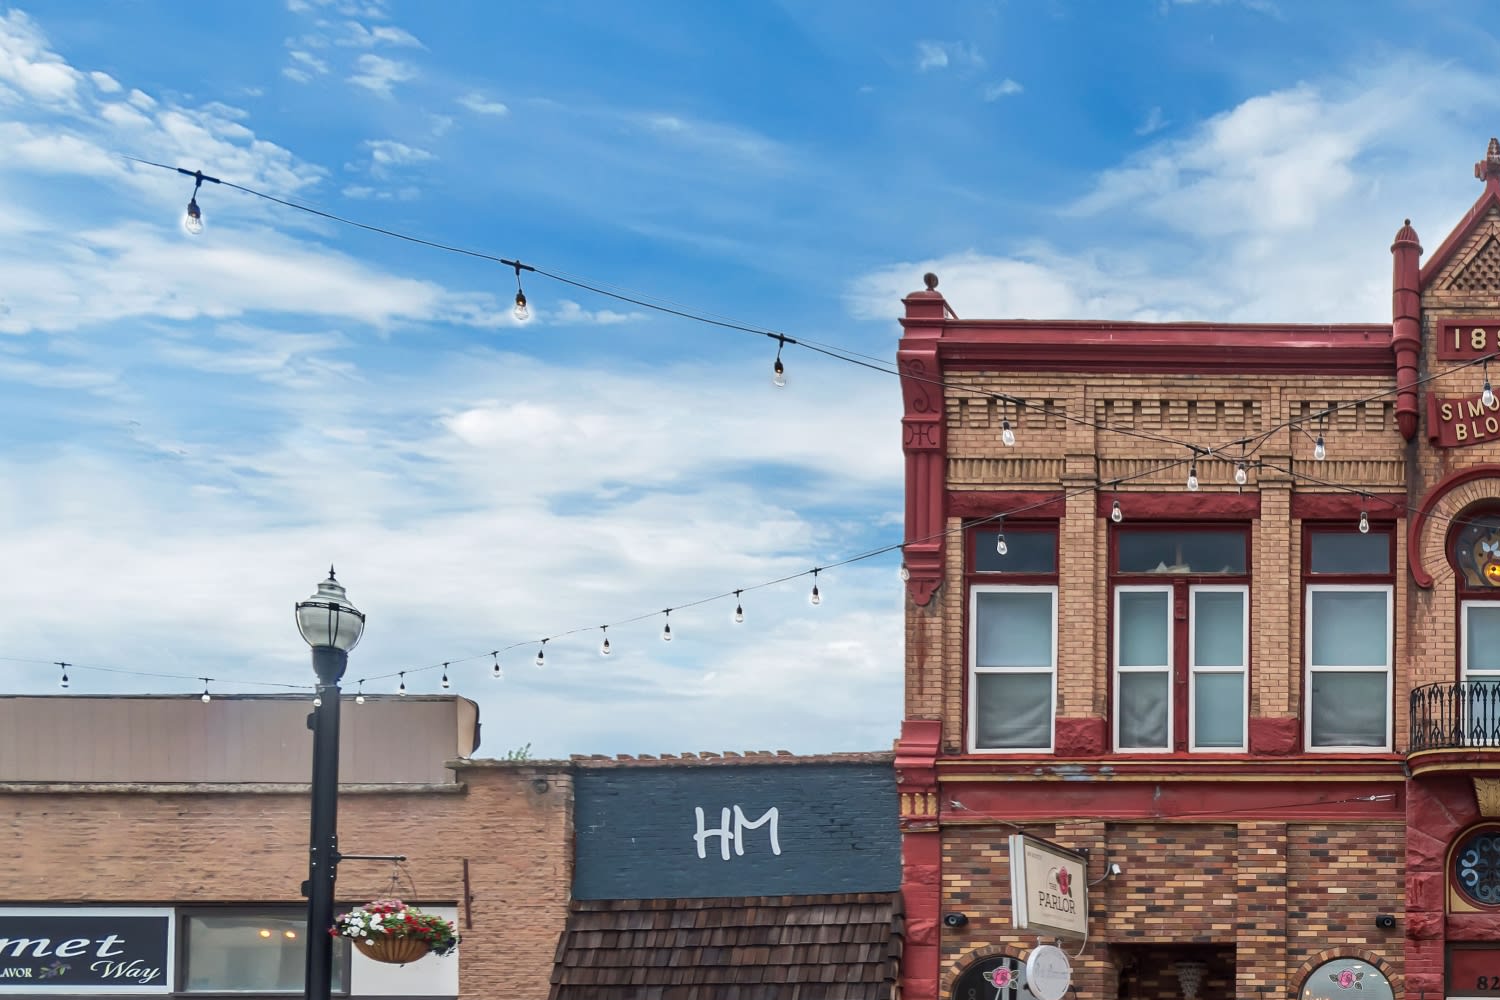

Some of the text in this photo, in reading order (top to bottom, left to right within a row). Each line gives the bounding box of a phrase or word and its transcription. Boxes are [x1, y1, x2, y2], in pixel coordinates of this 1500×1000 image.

[693, 804, 781, 861] HM
[1038, 890, 1076, 915] PARLOR
[0, 934, 125, 958] met
[90, 959, 161, 984] Way
[1476, 976, 1500, 991] 82
